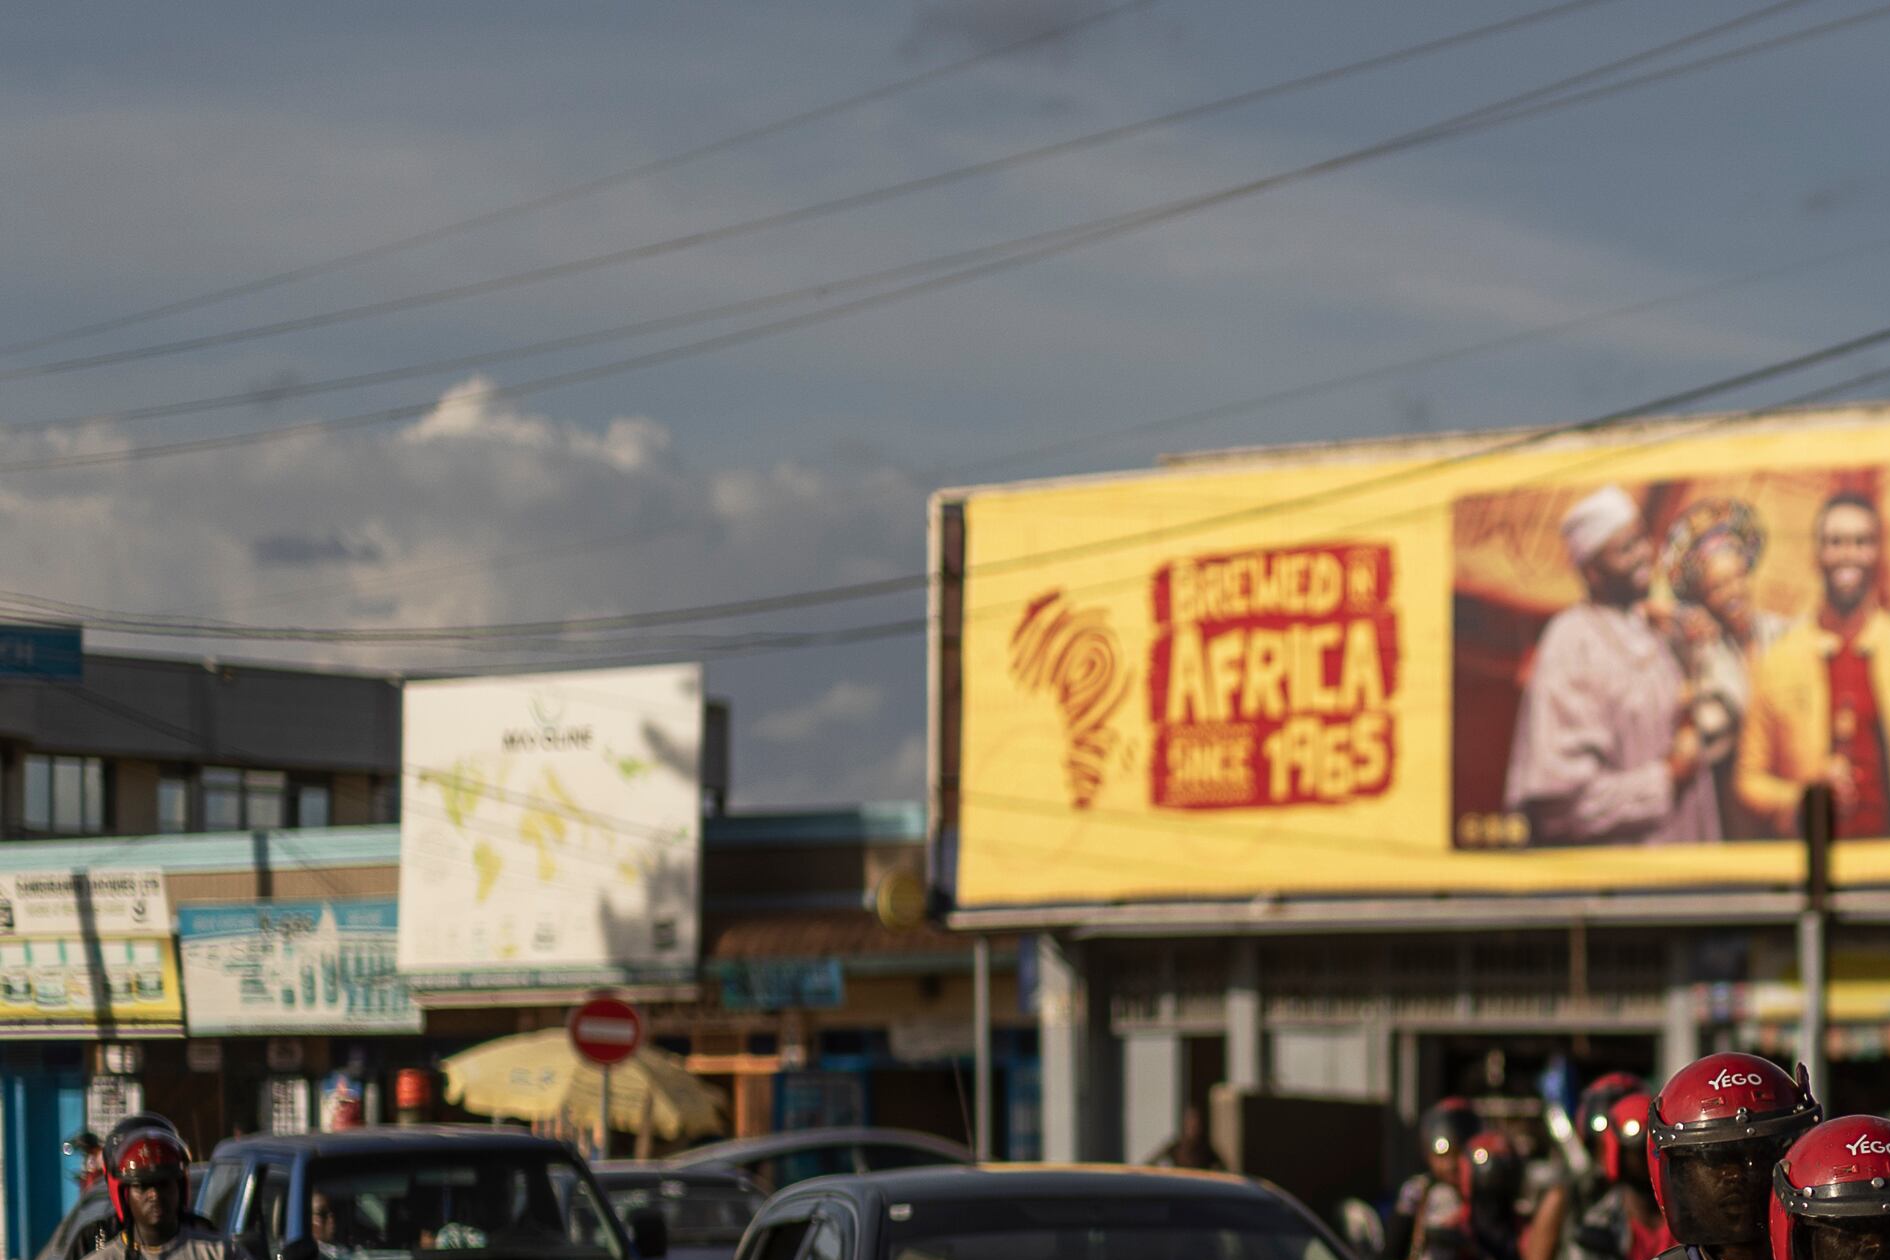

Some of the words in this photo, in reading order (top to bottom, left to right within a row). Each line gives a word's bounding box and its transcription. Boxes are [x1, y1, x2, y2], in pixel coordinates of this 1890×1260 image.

[1165, 616, 1387, 721] AFRICA
[1262, 711, 1388, 801] 1965
[1708, 1068, 1762, 1091] YEGO
